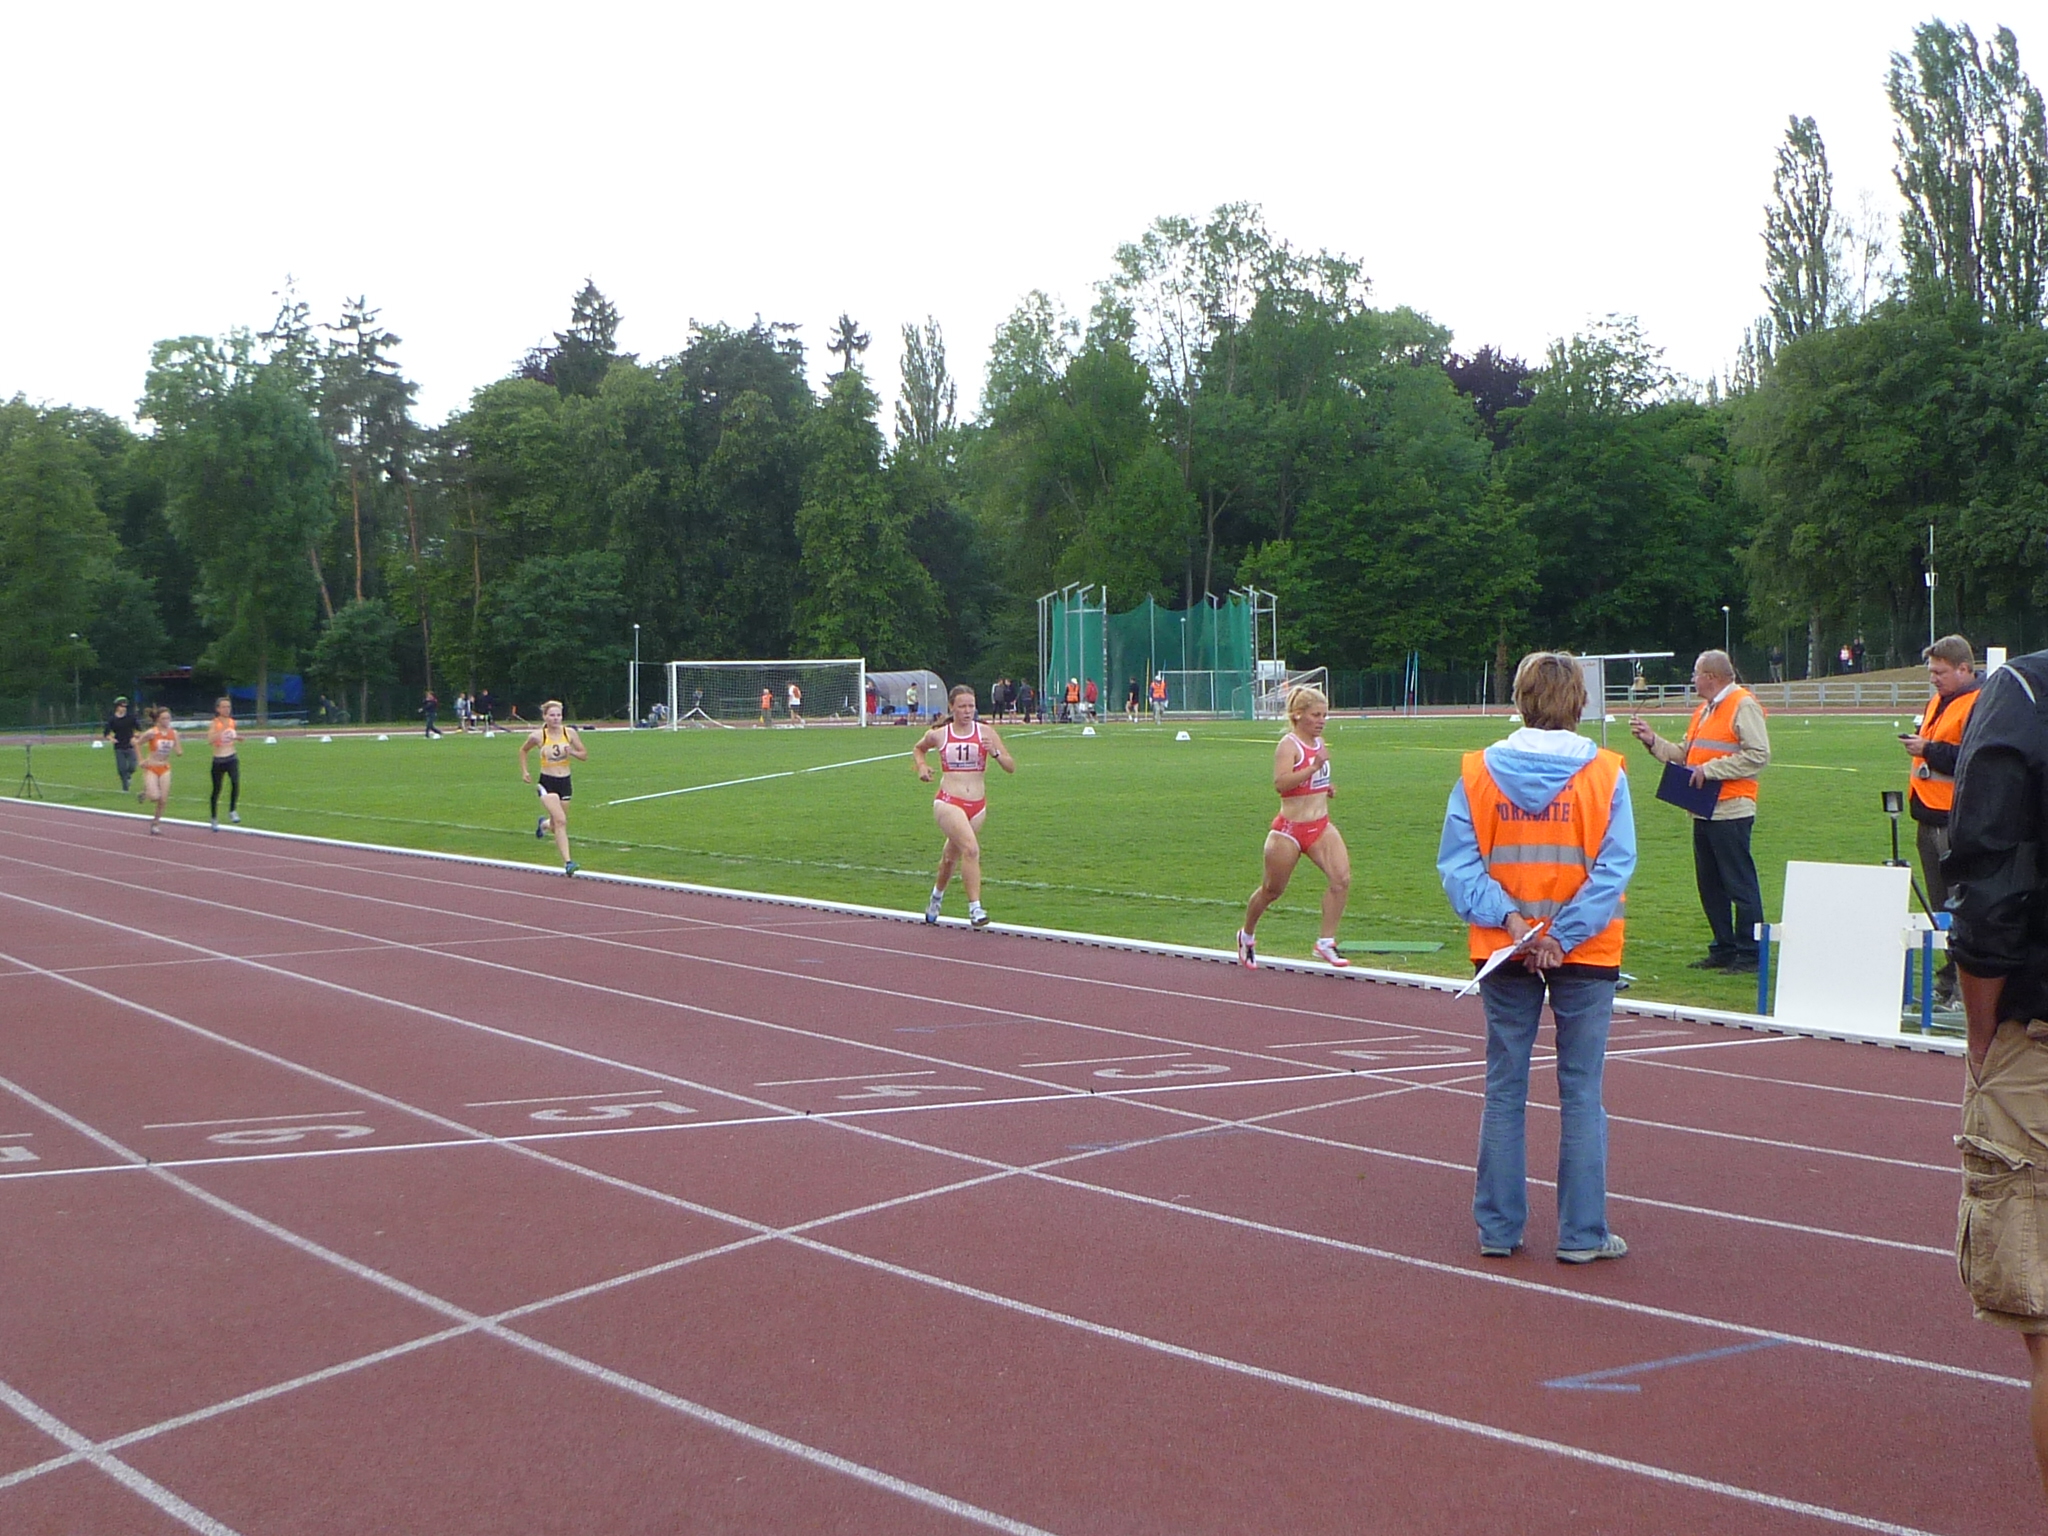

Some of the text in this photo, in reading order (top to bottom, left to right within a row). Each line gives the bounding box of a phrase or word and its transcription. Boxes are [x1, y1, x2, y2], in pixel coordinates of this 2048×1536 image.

[552, 744, 561, 757] 3
[956, 744, 969, 761] 11
[1093, 1063, 1231, 1079] 3
[530, 1101, 698, 1121] 5
[207, 1124, 375, 1144] 6
